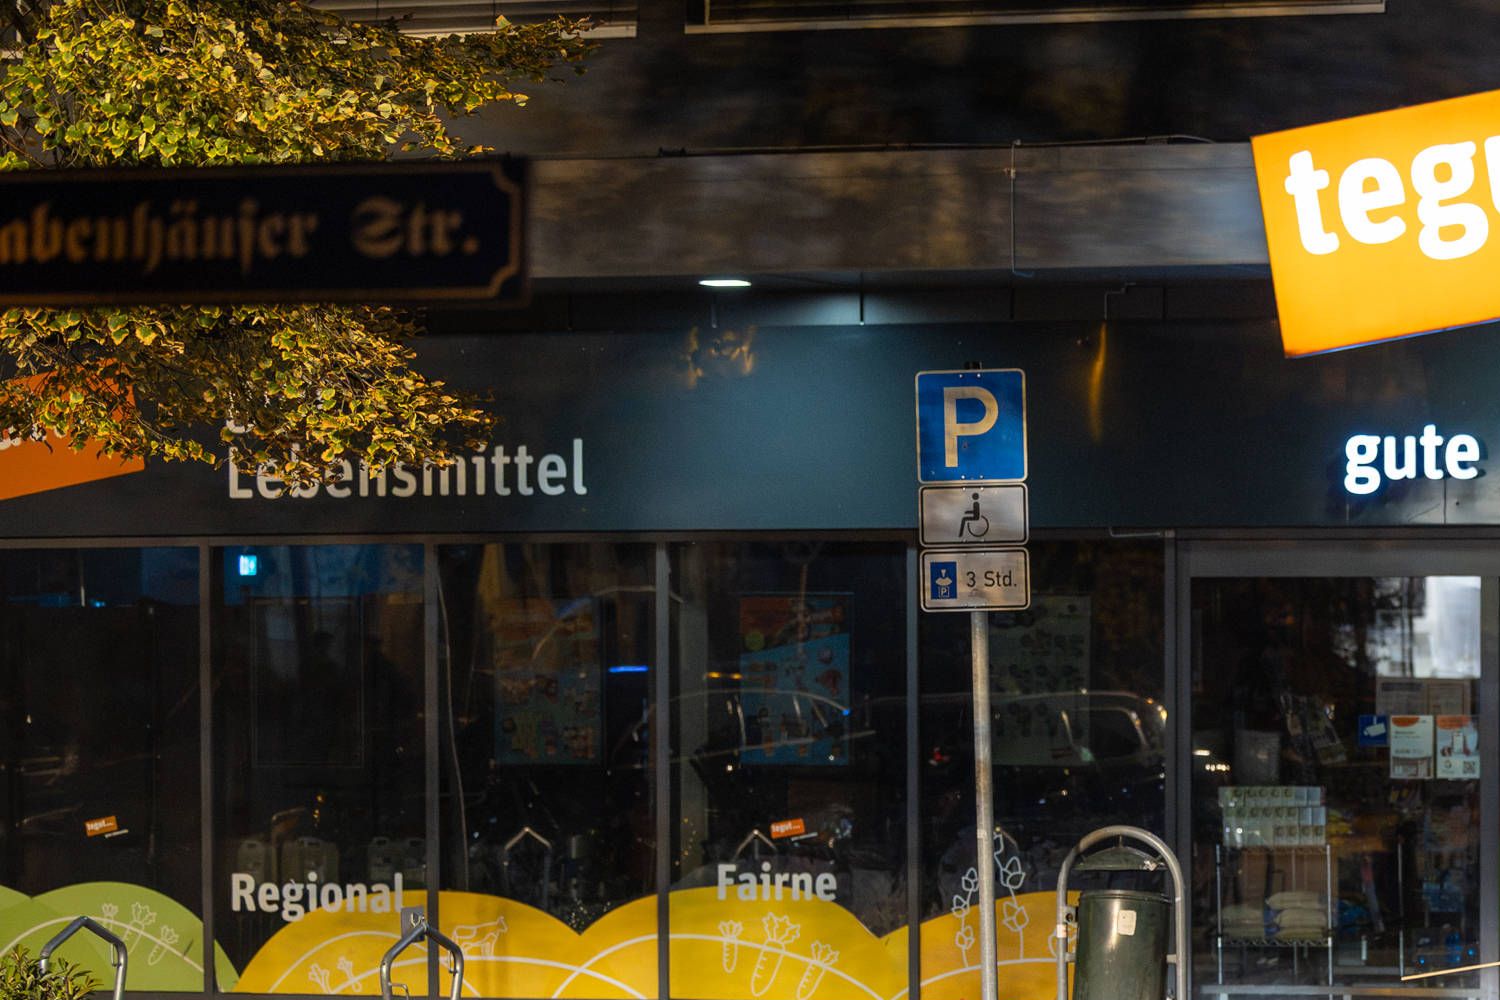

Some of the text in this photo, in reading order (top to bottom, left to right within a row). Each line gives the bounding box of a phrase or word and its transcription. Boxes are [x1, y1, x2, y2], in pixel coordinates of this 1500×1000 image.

[0, 198, 480, 276] abenhäuser Str.
[944, 387, 999, 467] P
[228, 438, 588, 499] Lebensmittel
[1344, 424, 1480, 494] gute
[966, 571, 977, 588] 3
[984, 570, 1018, 588] Std.
[231, 871, 403, 923] Regional
[717, 861, 838, 902] Fairne
